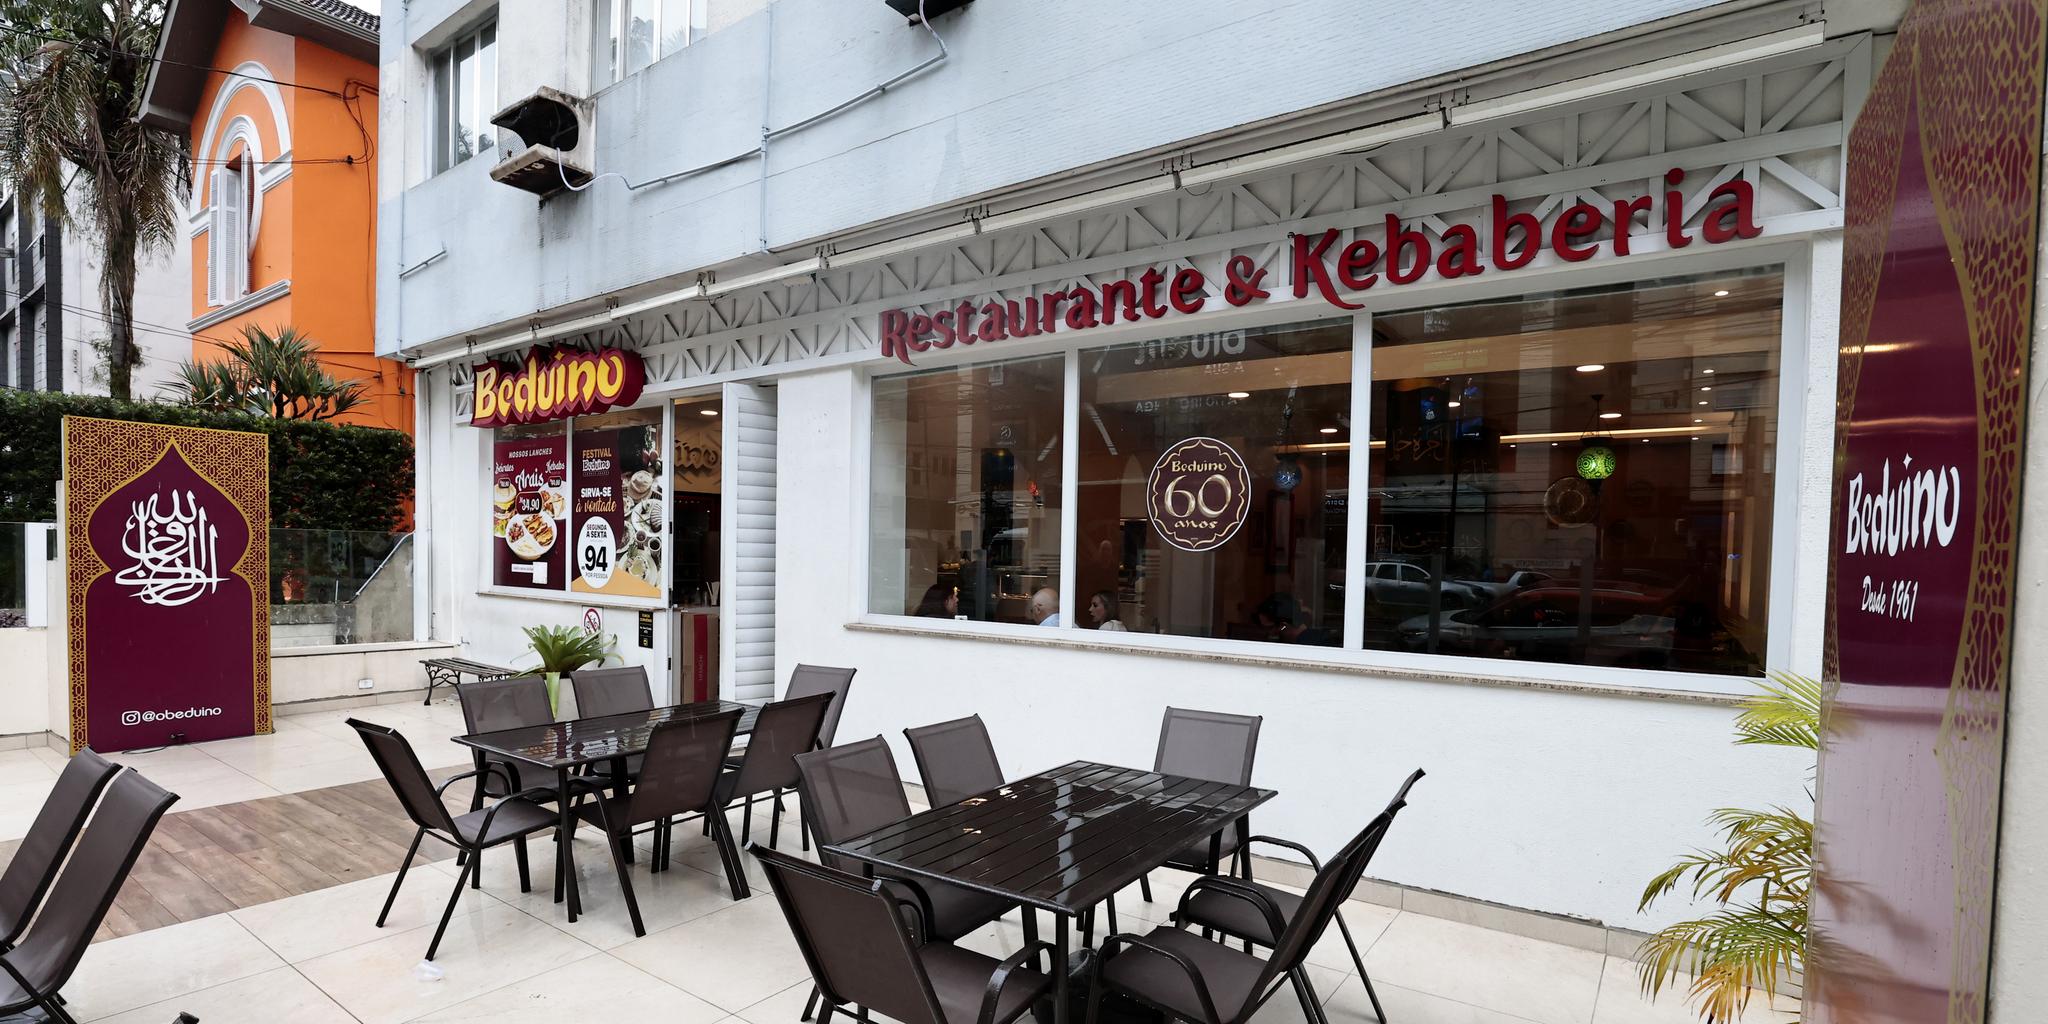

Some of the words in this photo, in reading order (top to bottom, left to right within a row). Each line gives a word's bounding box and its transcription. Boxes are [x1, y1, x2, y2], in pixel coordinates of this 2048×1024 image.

[880, 267, 1206, 366] Restaurante
[1225, 255, 1270, 306] &
[1293, 167, 1764, 311] Kebaberia
[474, 351, 624, 420] Beduino
[509, 450, 528, 459] NOSSOS
[529, 448, 552, 456] LANCHES
[582, 448, 612, 459] FESTIVAL
[545, 459, 565, 474] Kebabs
[1171, 460, 1227, 473] Beduino
[515, 468, 545, 492] Arais
[581, 487, 612, 498] SIRVA-SE
[1164, 473, 1232, 518] 60
[575, 499, 583, 513] à
[584, 497, 617, 513] vontade
[1846, 453, 1960, 557] Beduino
[1174, 520, 1218, 529] anos
[585, 545, 608, 572] 94
[1862, 575, 1886, 615] Desde
[1889, 580, 1919, 621] 1961
[142, 706, 222, 723] @obeduino
